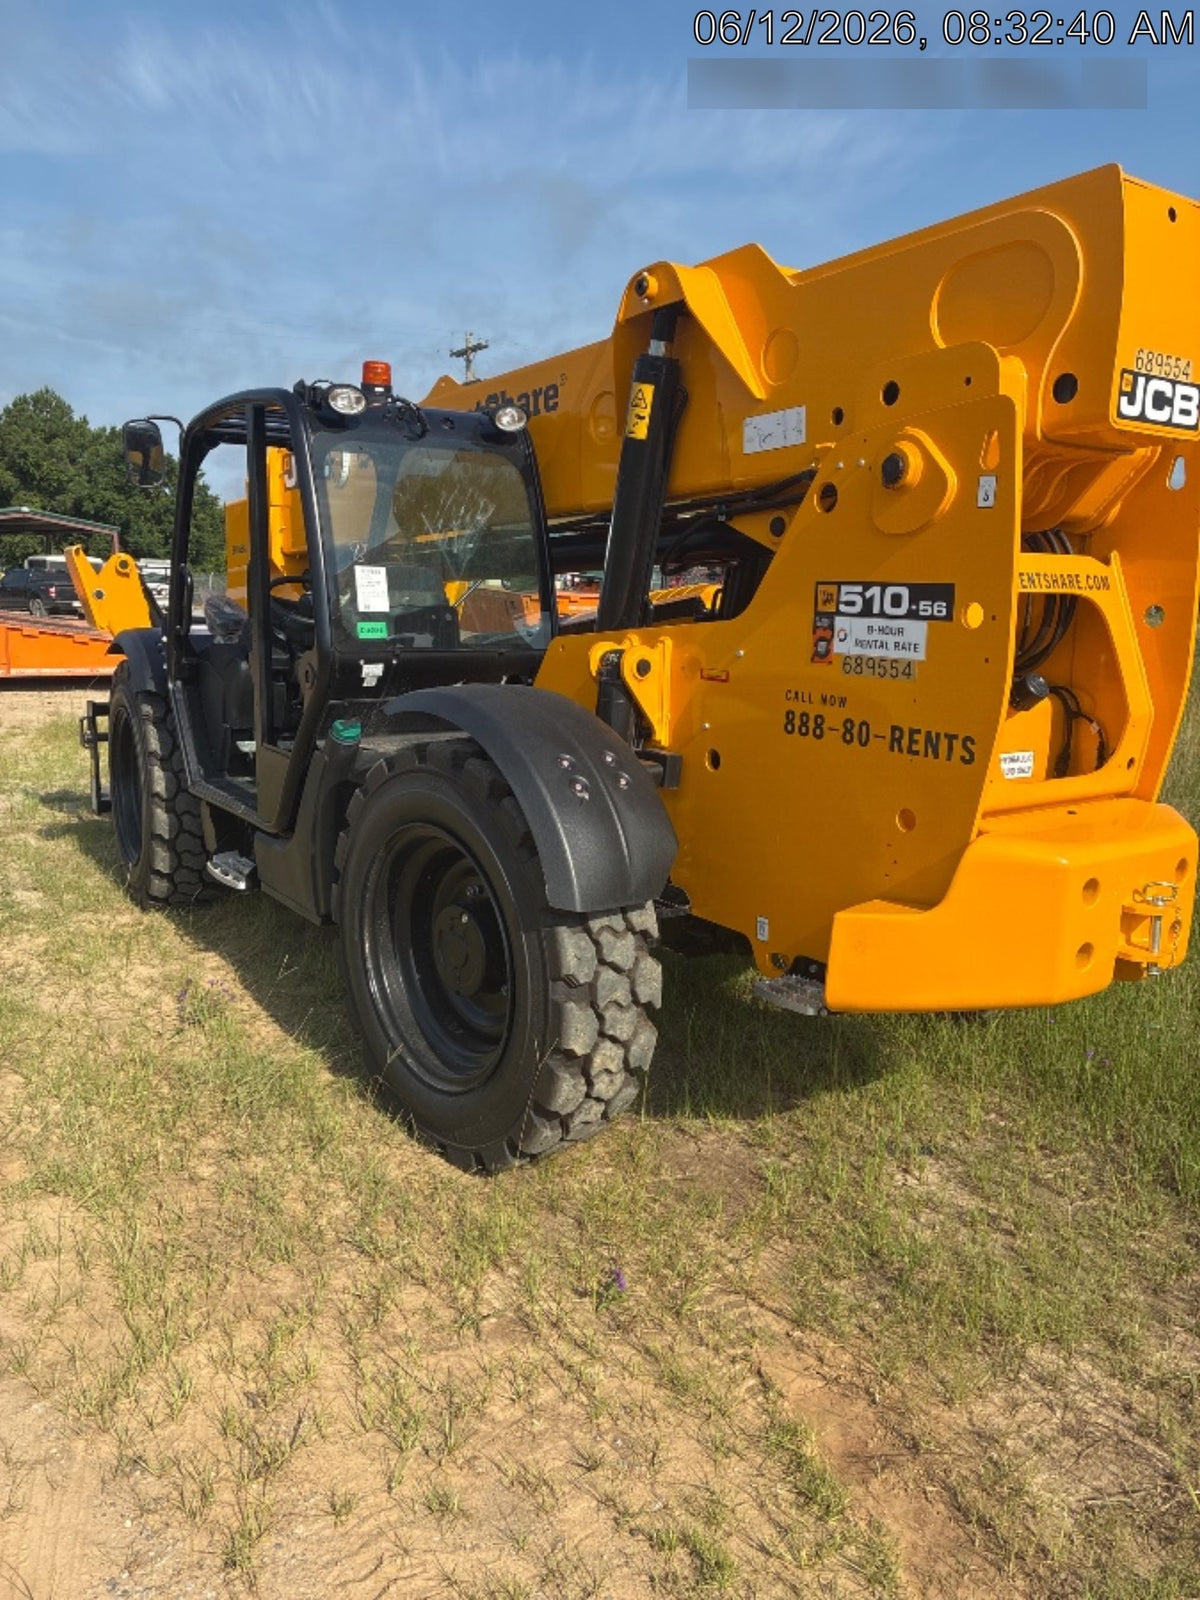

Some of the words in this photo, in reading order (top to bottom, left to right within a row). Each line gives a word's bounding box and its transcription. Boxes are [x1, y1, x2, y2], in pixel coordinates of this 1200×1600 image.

[1135, 348, 1190, 381] 689554
[1120, 376, 1200, 426] JCB
[867, 625, 904, 637] 8-HOUR
[854, 638, 889, 651] RENTAL
[894, 641, 919, 653] RATE
[842, 655, 912, 679] 689554
[785, 689, 813, 705] CALL
[820, 695, 848, 708] NOW
[783, 709, 976, 766] 888-80-RENTS
